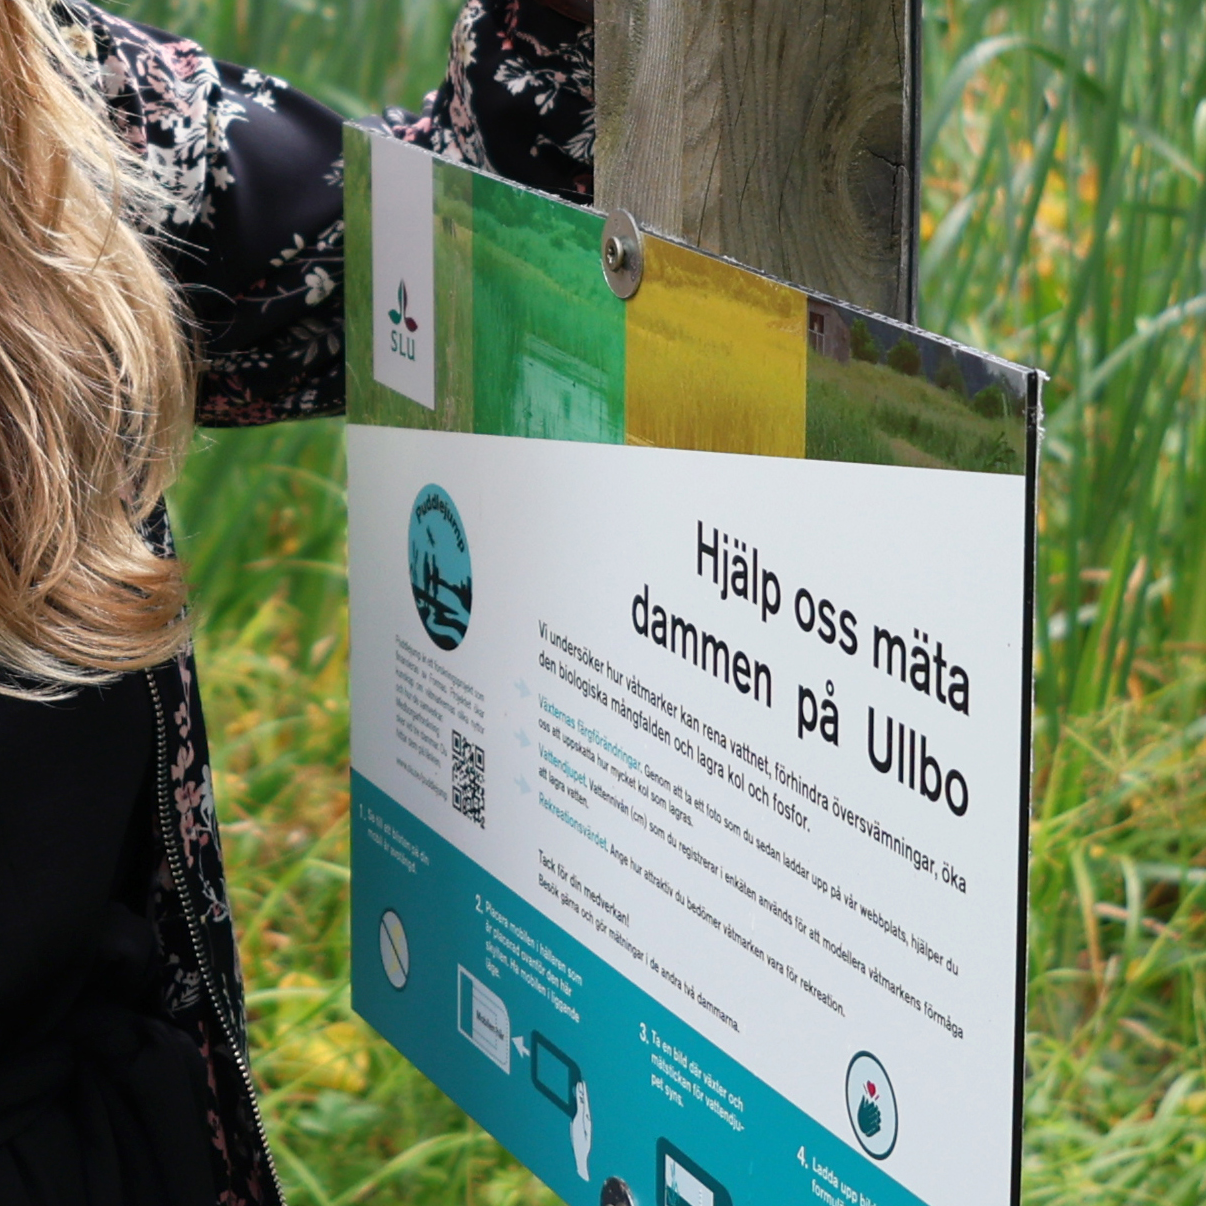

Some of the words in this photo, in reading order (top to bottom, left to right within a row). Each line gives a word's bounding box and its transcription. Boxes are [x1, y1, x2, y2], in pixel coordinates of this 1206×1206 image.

[391, 330, 415, 361] SLU
[696, 519, 781, 623] Hjälp
[794, 587, 858, 656] oss
[873, 625, 970, 717] mäta
[539, 650, 556, 674] den
[559, 661, 607, 706] biologiska
[611, 698, 670, 745] mångfalden
[674, 737, 693, 759] och
[697, 746, 724, 779] lagra
[728, 765, 744, 791] kol
[748, 783, 769, 806] och
[773, 793, 810, 832] fosfor.
[539, 620, 547, 640] Vi
[550, 632, 604, 673] undersöker
[607, 661, 623, 685] hur
[626, 675, 677, 718] våtmarker
[681, 705, 699, 732] kan
[703, 724, 726, 749] rena
[730, 740, 771, 779] vattnet,
[775, 762, 828, 811] förhindra
[832, 796, 937, 880] översvämningar,
[942, 862, 966, 893] öka
[632, 583, 772, 709] dammen
[798, 679, 840, 747] på
[868, 705, 969, 817] Ullbo
[538, 719, 550, 733] oss
[552, 727, 560, 740] att
[562, 735, 595, 762] uppskatta
[597, 753, 609, 771] hur
[611, 766, 636, 789] mycket
[638, 780, 649, 798] kol
[651, 792, 666, 809] som
[669, 800, 693, 827] lagras.
[539, 767, 547, 780] att
[549, 771, 565, 792] lagra
[539, 694, 575, 729] Växternas
[644, 764, 671, 791] Genom
[673, 785, 683, 799] att
[685, 790, 692, 805] ta
[694, 799, 704, 813] ett
[706, 803, 721, 824] foto
[724, 818, 740, 836] som
[743, 829, 753, 844] du
[756, 839, 780, 862] sedan
[783, 852, 809, 879] laddar
[812, 875, 828, 893] upp
[831, 886, 841, 901] på
[844, 894, 857, 910] vår
[860, 905, 908, 946] webbplats,
[911, 934, 943, 965] hjälper
[946, 958, 958, 976] du
[475, 894, 484, 914] 2.
[567, 968, 582, 986] som
[539, 849, 555, 873] Tack
[558, 863, 568, 881] för
[570, 875, 581, 892] din
[584, 886, 629, 927] medverkan!
[539, 873, 558, 897] Besök
[561, 893, 579, 913] gärna
[581, 909, 593, 924] och
[595, 919, 607, 933] gör
[609, 929, 644, 961] mätningar
[650, 958, 659, 973] de
[661, 968, 681, 990] andra
[684, 982, 695, 999] två
[697, 993, 739, 1033] dammarna.
[589, 778, 628, 815] Vattennivån
[631, 806, 647, 829] (cm)
[649, 822, 665, 839] som
[667, 832, 676, 848] du
[679, 842, 718, 875] registrerar
[725, 873, 756, 901] enkäten
[759, 895, 792, 925] används
[795, 916, 807, 934] för
[809, 929, 820, 944] att
[823, 938, 865, 974] modellera
[869, 967, 921, 1011] våtmarkens
[924, 1001, 963, 1039] förmåga
[610, 844, 628, 865] Ange
[630, 857, 642, 875] hur
[644, 870, 673, 897] attraktiv
[676, 890, 684, 905] du
[687, 896, 721, 930] bedömer
[723, 924, 764, 961] våtmarken
[767, 955, 783, 974] vara
[786, 965, 798, 983] för
[800, 978, 845, 1017] rekreation.
[639, 1022, 649, 1044] 3.
[652, 1030, 661, 1048] Ta
[662, 1042, 673, 1056] en
[673, 1047, 688, 1068] bild
[688, 1061, 702, 1079] där
[727, 1091, 743, 1112] och
[692, 1083, 704, 1101] för
[797, 1145, 809, 1169] 4.
[812, 1157, 839, 1188] Ladda
[840, 1182, 858, 1203] upp
